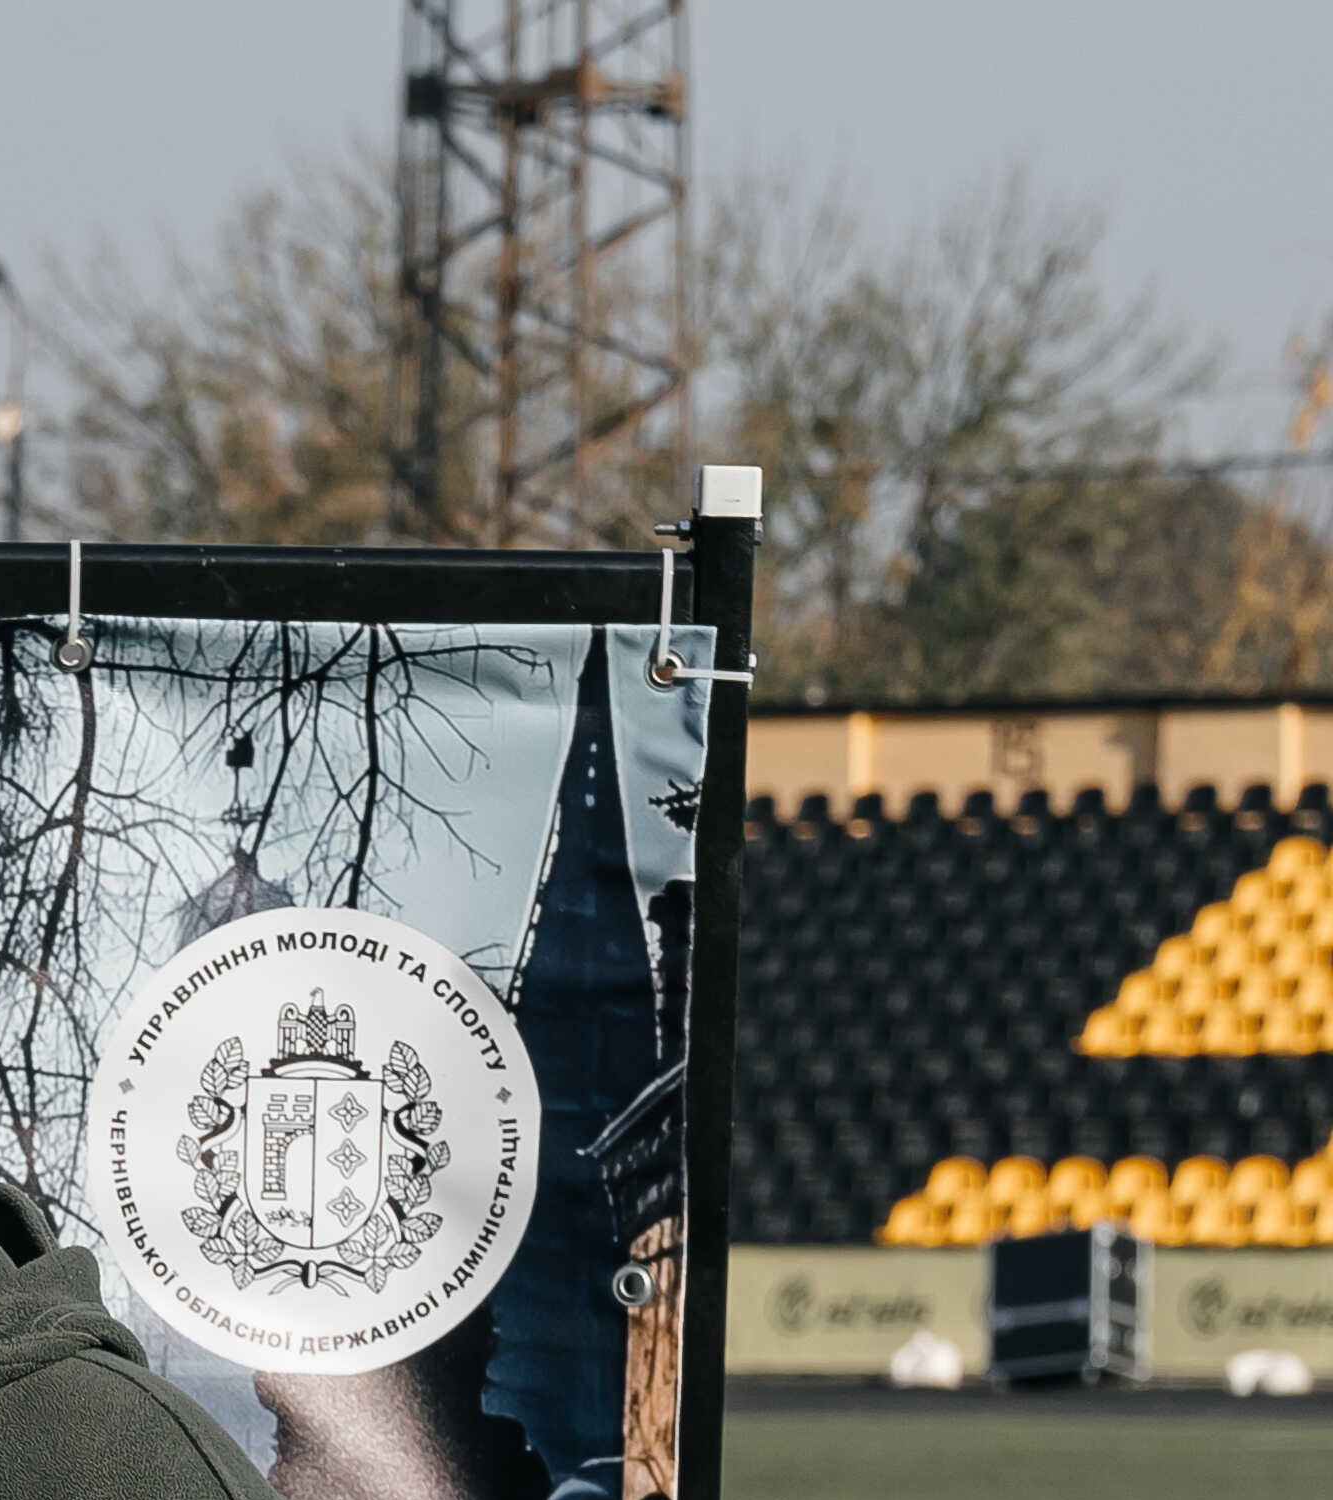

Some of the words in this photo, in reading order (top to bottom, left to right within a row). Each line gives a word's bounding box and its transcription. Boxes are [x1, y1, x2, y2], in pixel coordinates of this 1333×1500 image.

[129, 939, 268, 1066] УПРАВЛІННЯ
[277, 931, 388, 964] МОЛОДІ
[397, 950, 427, 983] ТА
[432, 978, 507, 1074] СПОРТУ
[109, 1109, 181, 1288] ЧЕРНІВЕЦЬКОЇ
[174, 1285, 293, 1352] ОБЛАСНОЇ
[299, 1293, 439, 1356] ДЕРЖАВНОЇ
[442, 1117, 519, 1300] АДМІНІСТРАЦІЇ
